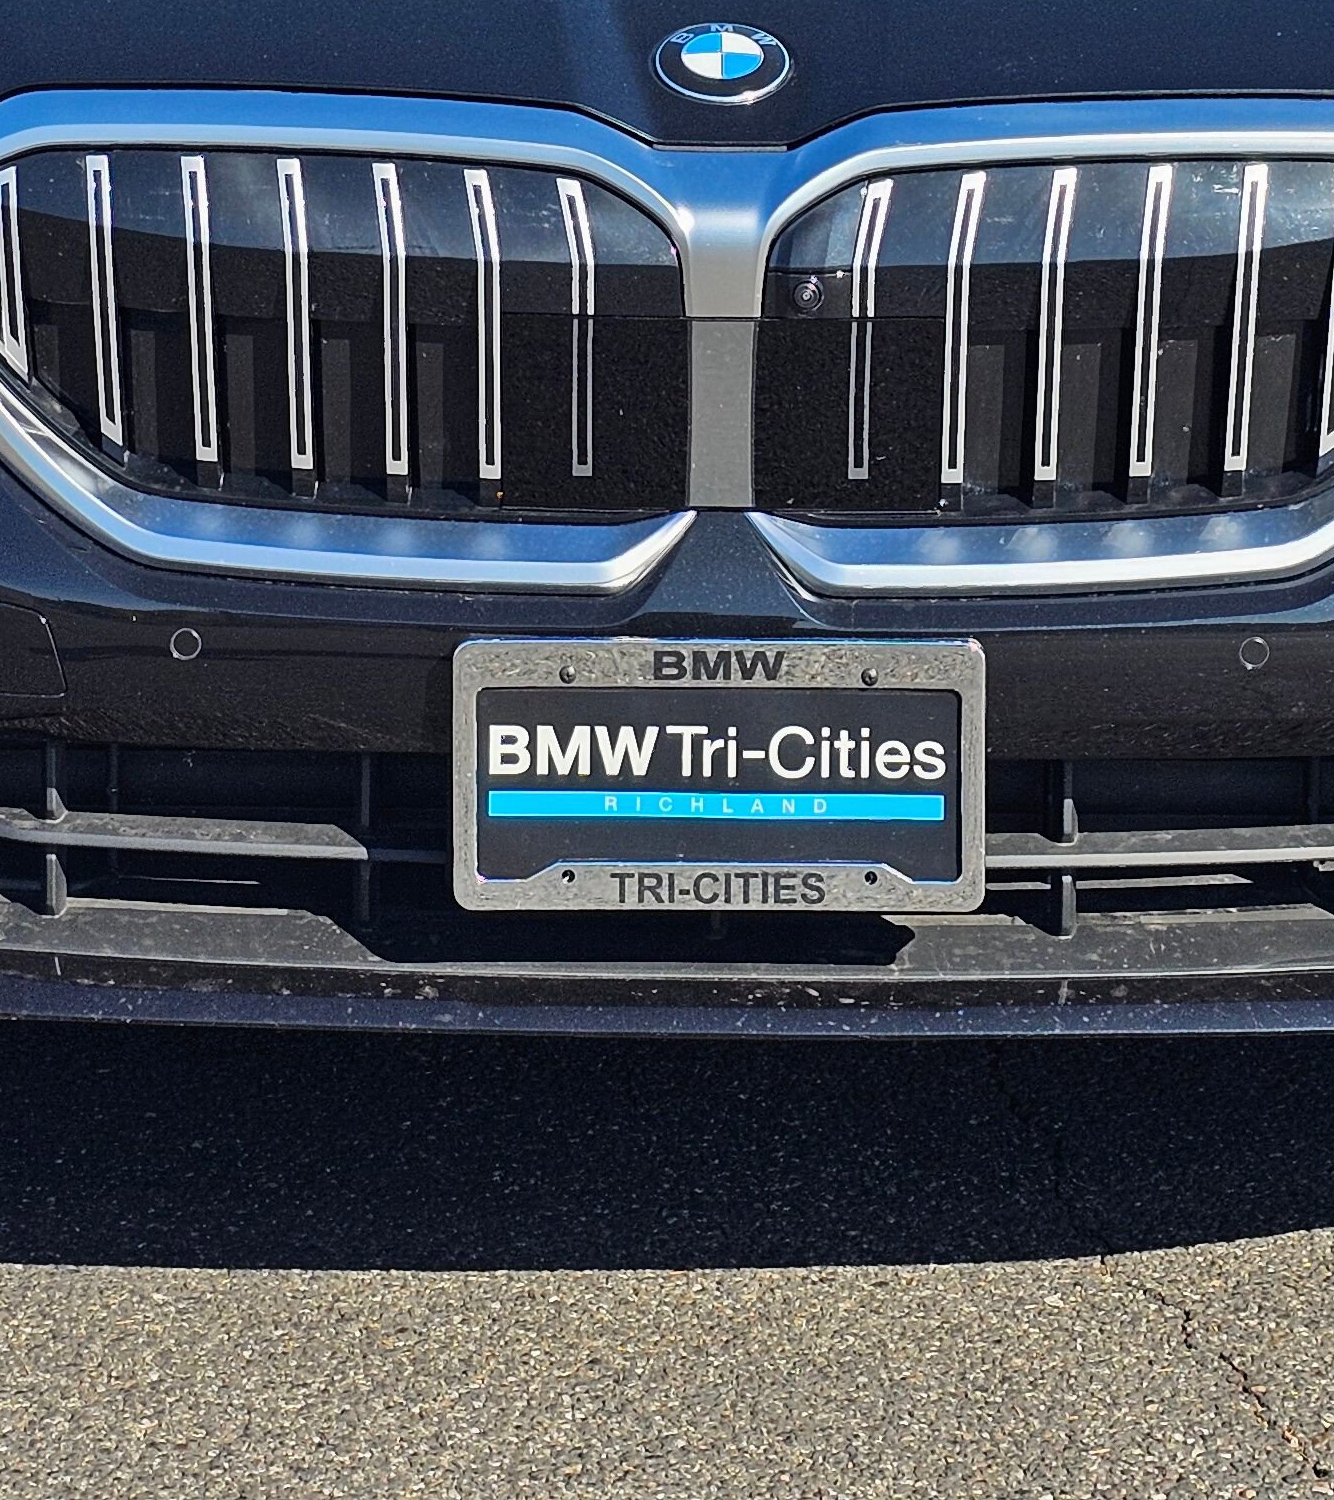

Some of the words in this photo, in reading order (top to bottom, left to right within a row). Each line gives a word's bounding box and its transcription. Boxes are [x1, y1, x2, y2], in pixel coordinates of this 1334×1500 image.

[671, 24, 777, 47] BMW
[652, 650, 787, 681] BMW
[488, 724, 661, 778] BMW
[665, 724, 947, 780] Tri-Cities
[604, 795, 829, 814] RICHLAND
[610, 871, 827, 905] TRI-CITIES
